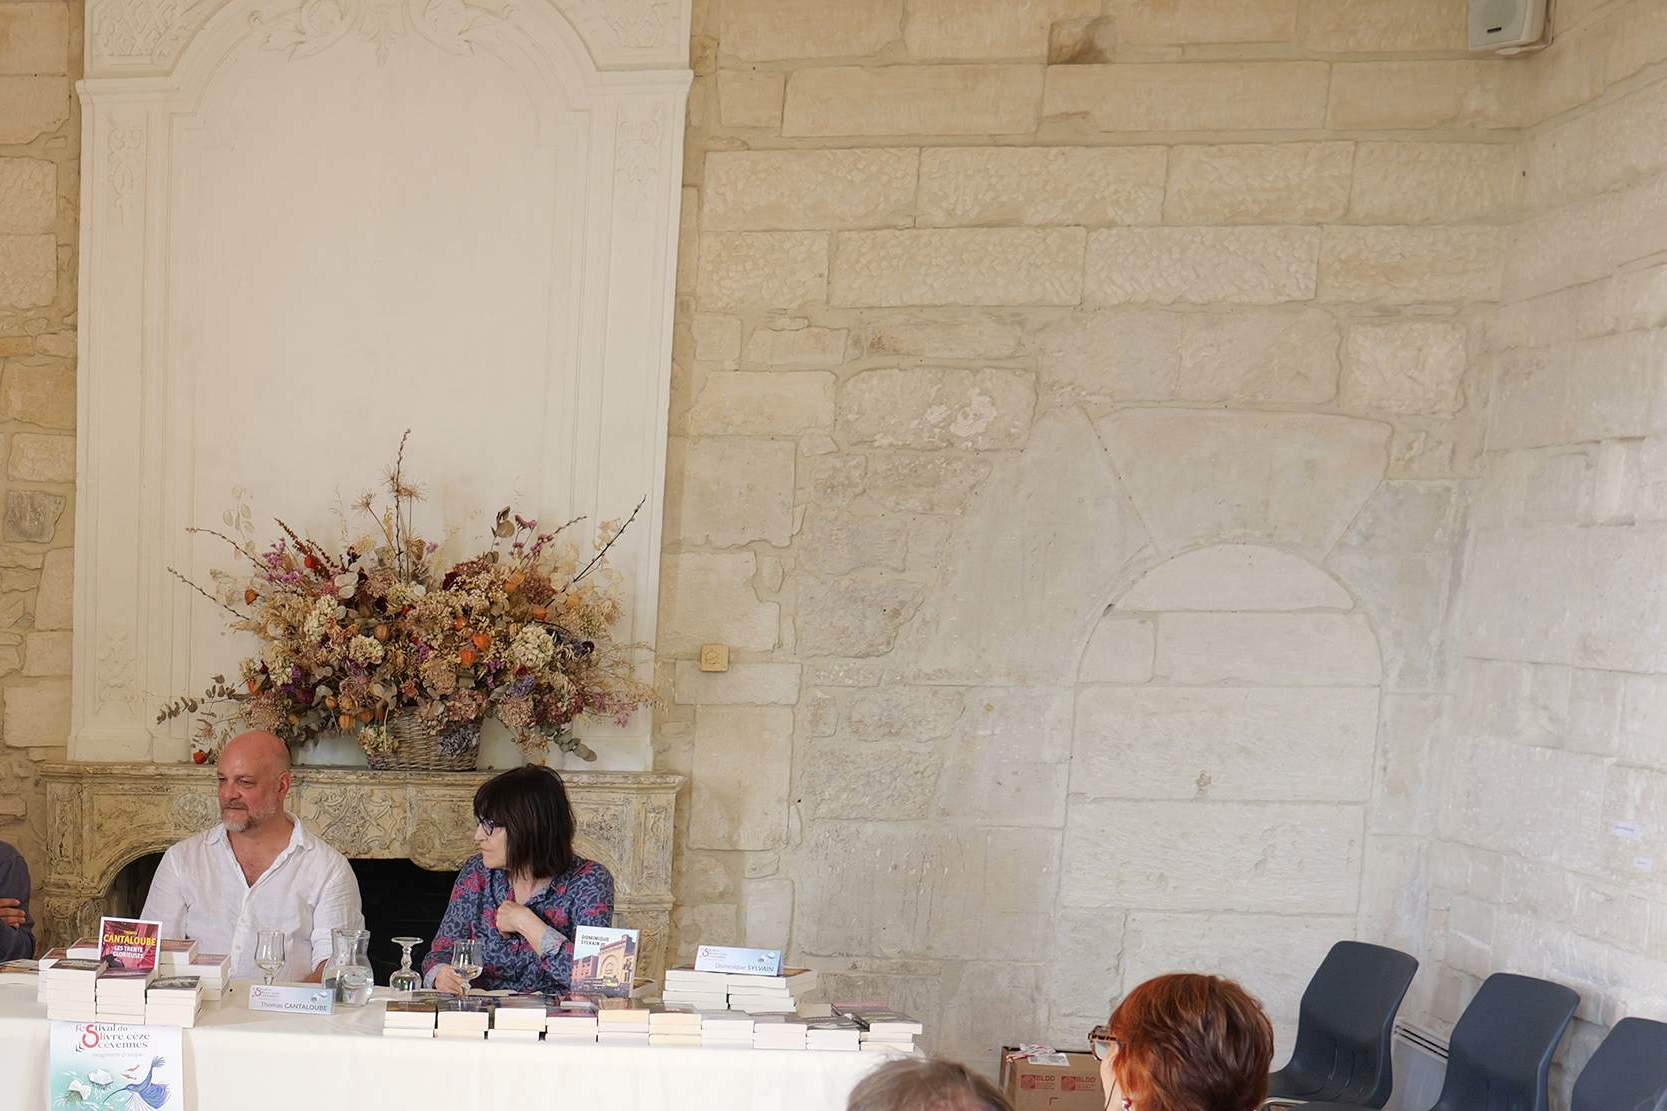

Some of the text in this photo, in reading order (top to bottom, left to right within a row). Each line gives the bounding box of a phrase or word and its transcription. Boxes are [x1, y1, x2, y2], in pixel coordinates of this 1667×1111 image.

[103, 933, 156, 947] CANTALOUBE
[581, 934, 610, 942] DOMINIQUE
[112, 951, 144, 959] GLORIEUSES
[715, 962, 775, 972] Dominique SYLVAIN
[284, 1003, 328, 1012] CANTALOUBE
[100, 1032, 150, 1041] livre cèze
